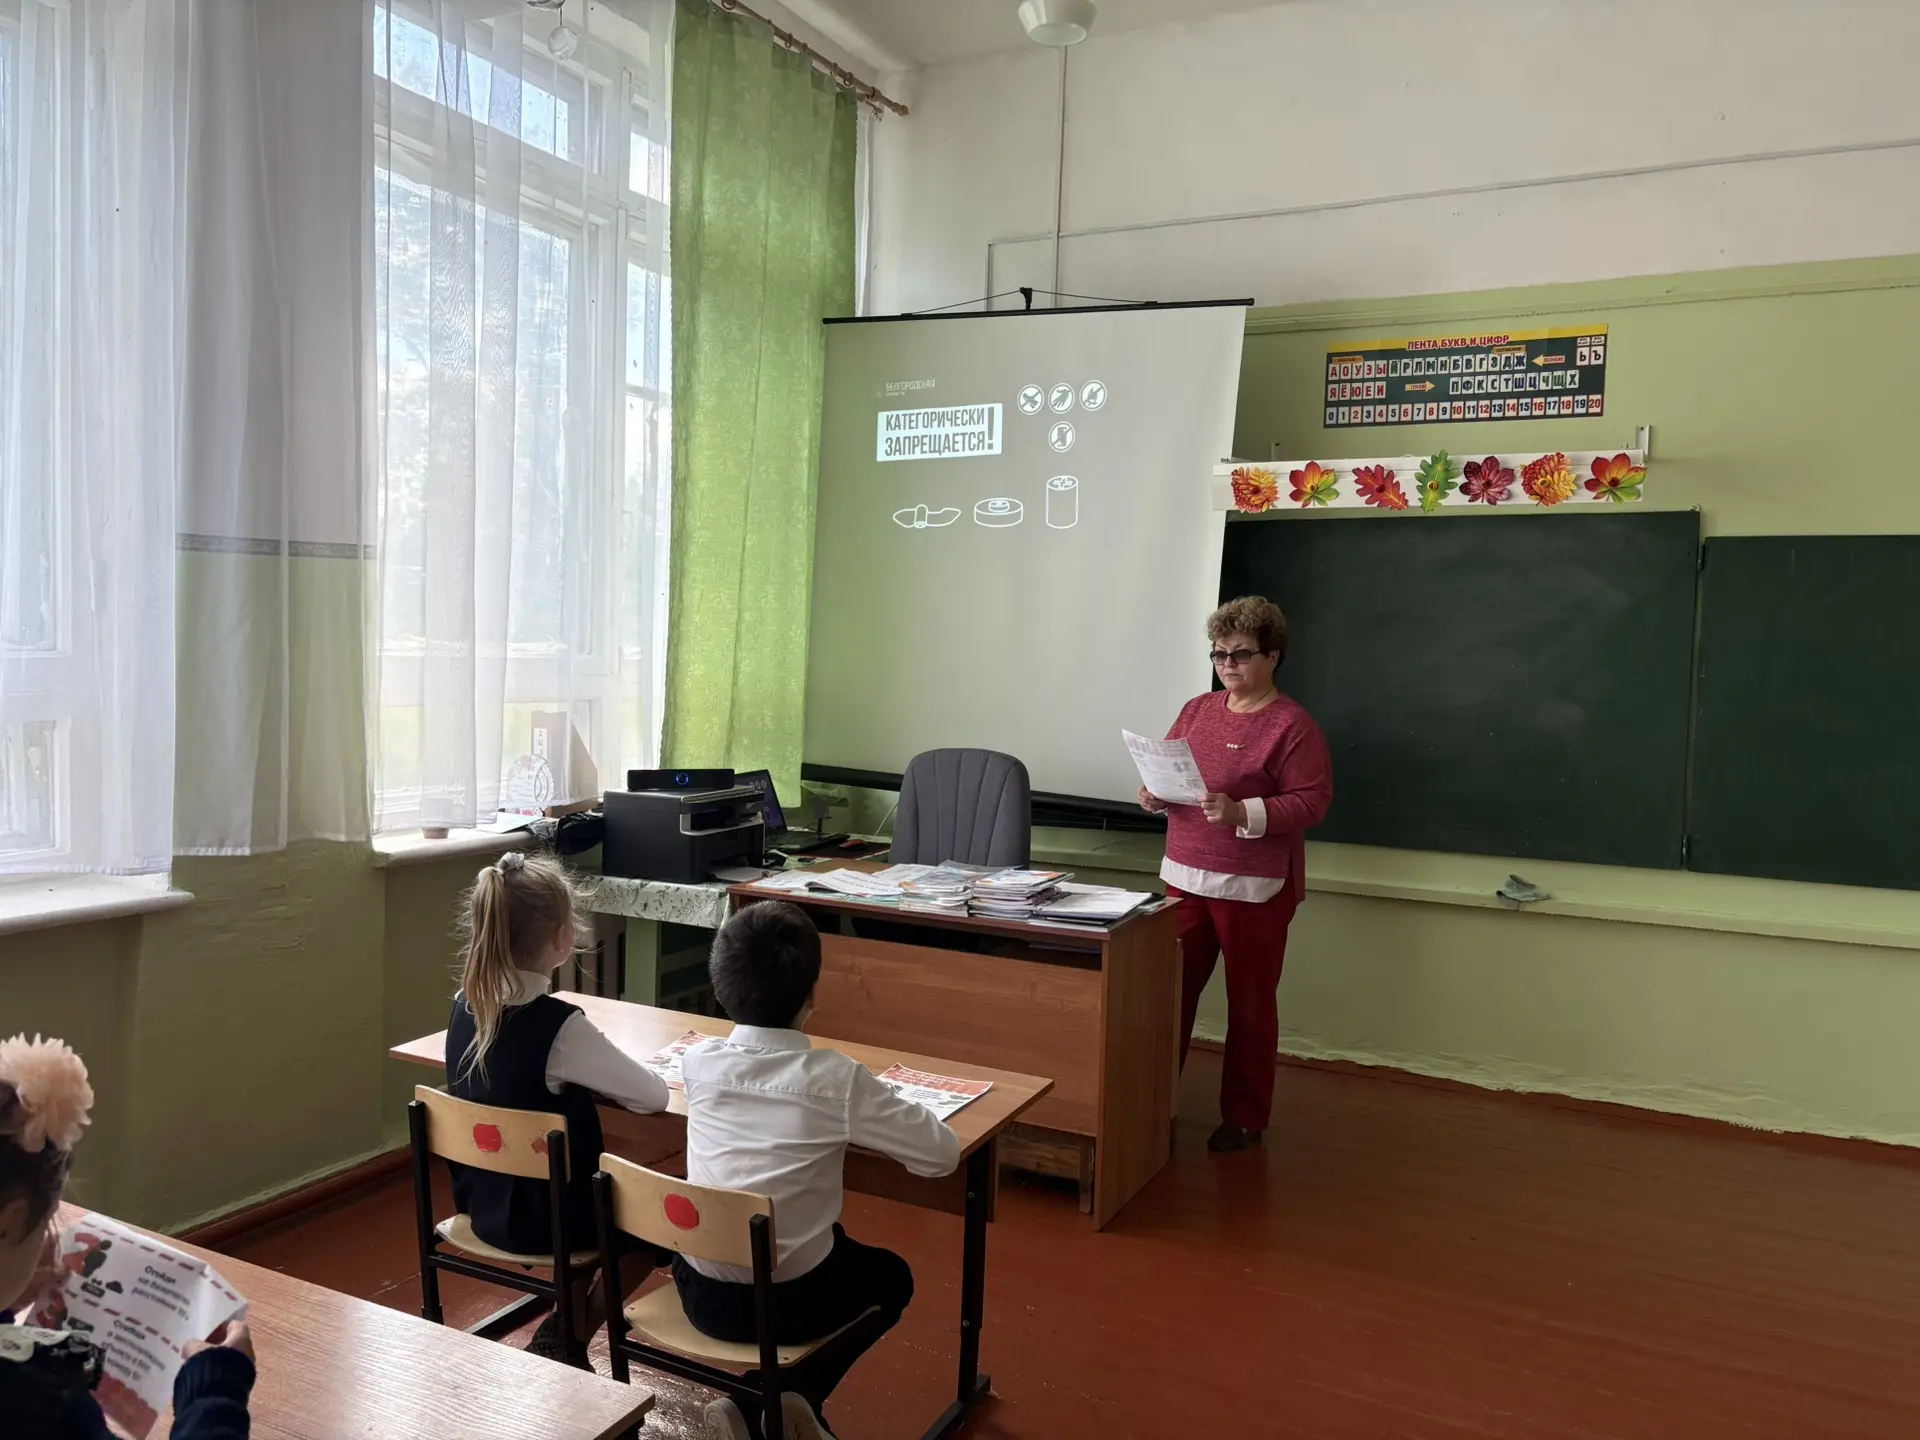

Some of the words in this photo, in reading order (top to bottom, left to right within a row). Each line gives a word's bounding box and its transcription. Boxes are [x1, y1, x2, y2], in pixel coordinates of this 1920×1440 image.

[1407, 340, 1438, 350] ЛЕНТА
[1441, 338, 1467, 348] БУКВ
[1470, 337, 1476, 346] И
[1480, 335, 1509, 346] ЦИФР
[886, 407, 985, 431] КАТЕГОРИЧЕСКИ
